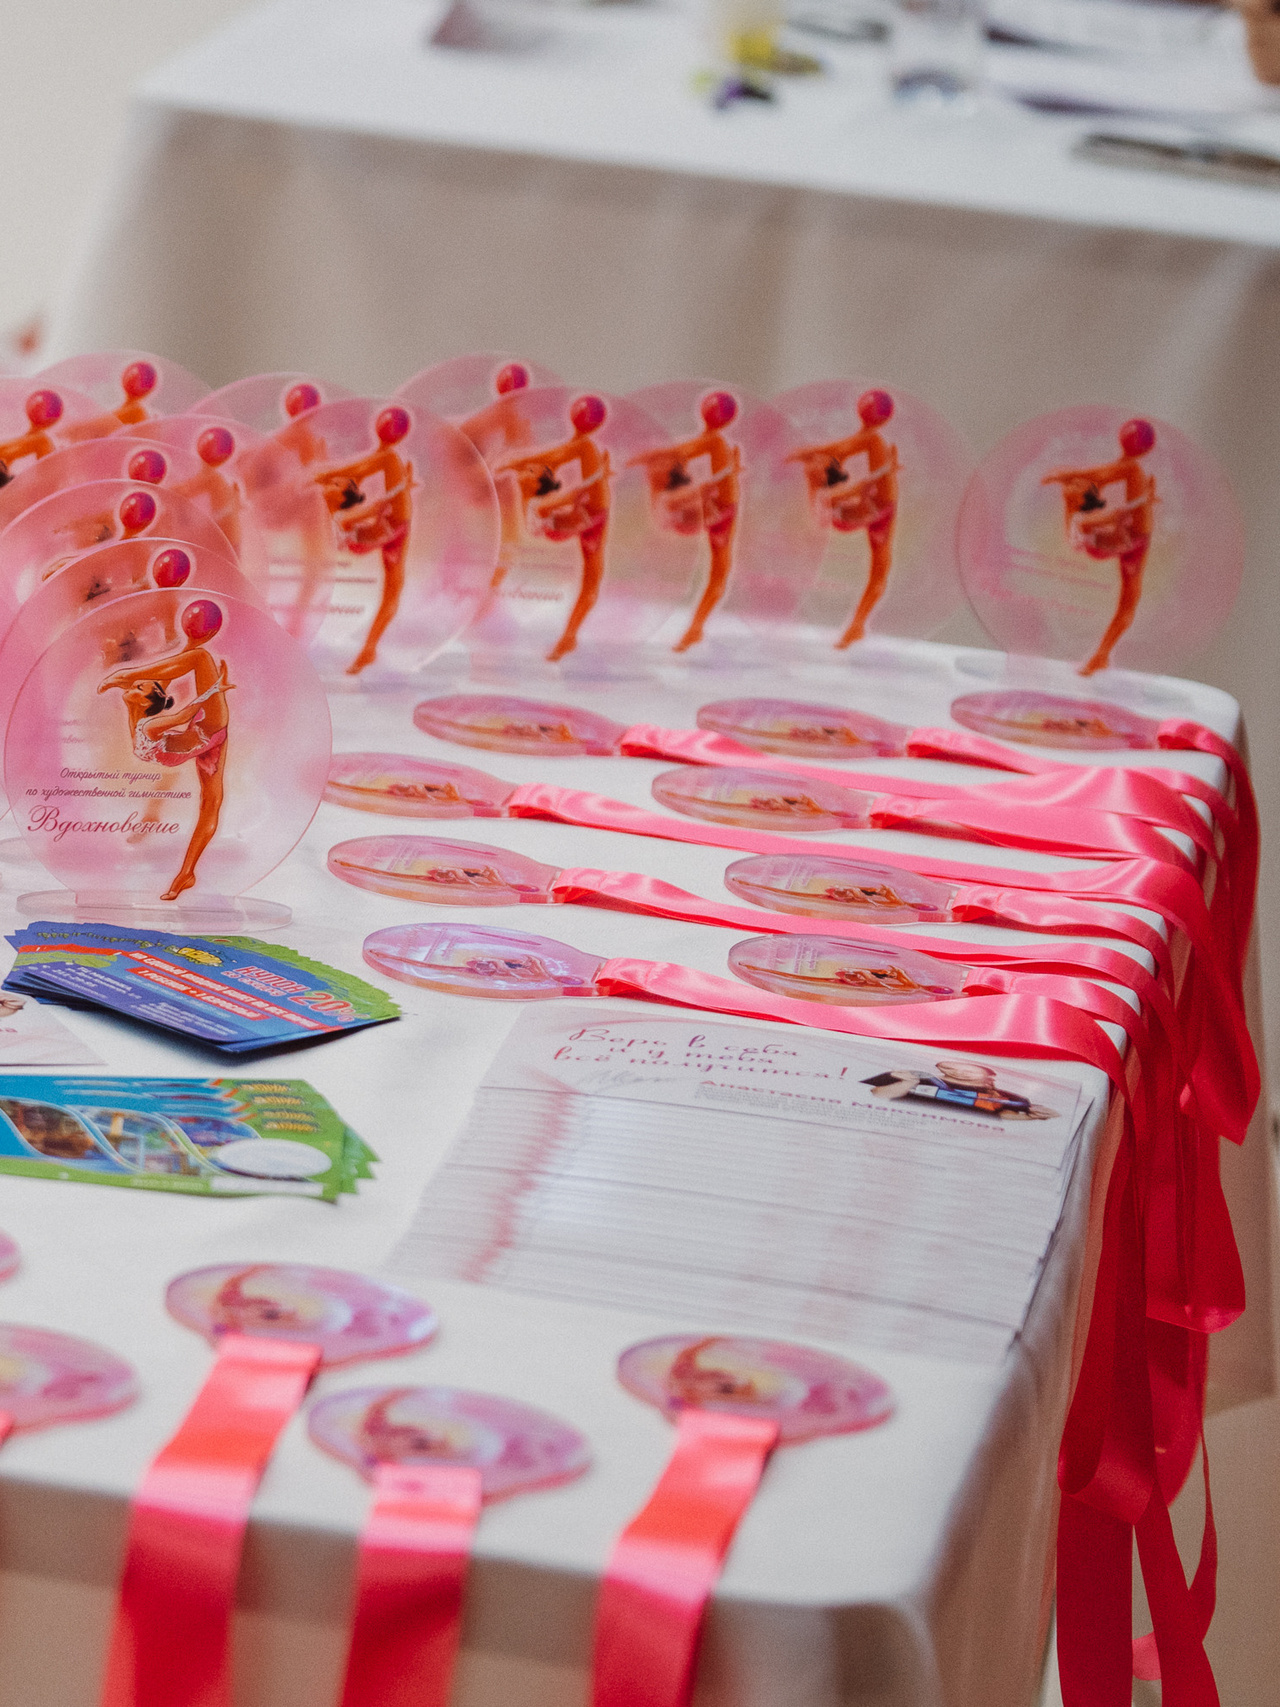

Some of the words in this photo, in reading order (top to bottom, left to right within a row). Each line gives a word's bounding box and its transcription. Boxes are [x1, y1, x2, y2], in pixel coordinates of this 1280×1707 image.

[59, 767, 120, 780] Открытый
[121, 771, 162, 785] турнир
[25, 787, 38, 796] по
[41, 786, 126, 801] художественной
[128, 789, 192, 799] гимнастике
[27, 804, 180, 842] Вдохновение
[232, 965, 312, 994] КУПОН
[287, 990, 371, 1022] 20%
[569, 1028, 667, 1047] Верь
[724, 1043, 797, 1057] себя
[686, 1051, 773, 1064] тебя
[700, 1080, 843, 1104] Анастасия
[852, 1101, 1006, 1132] Максимова
